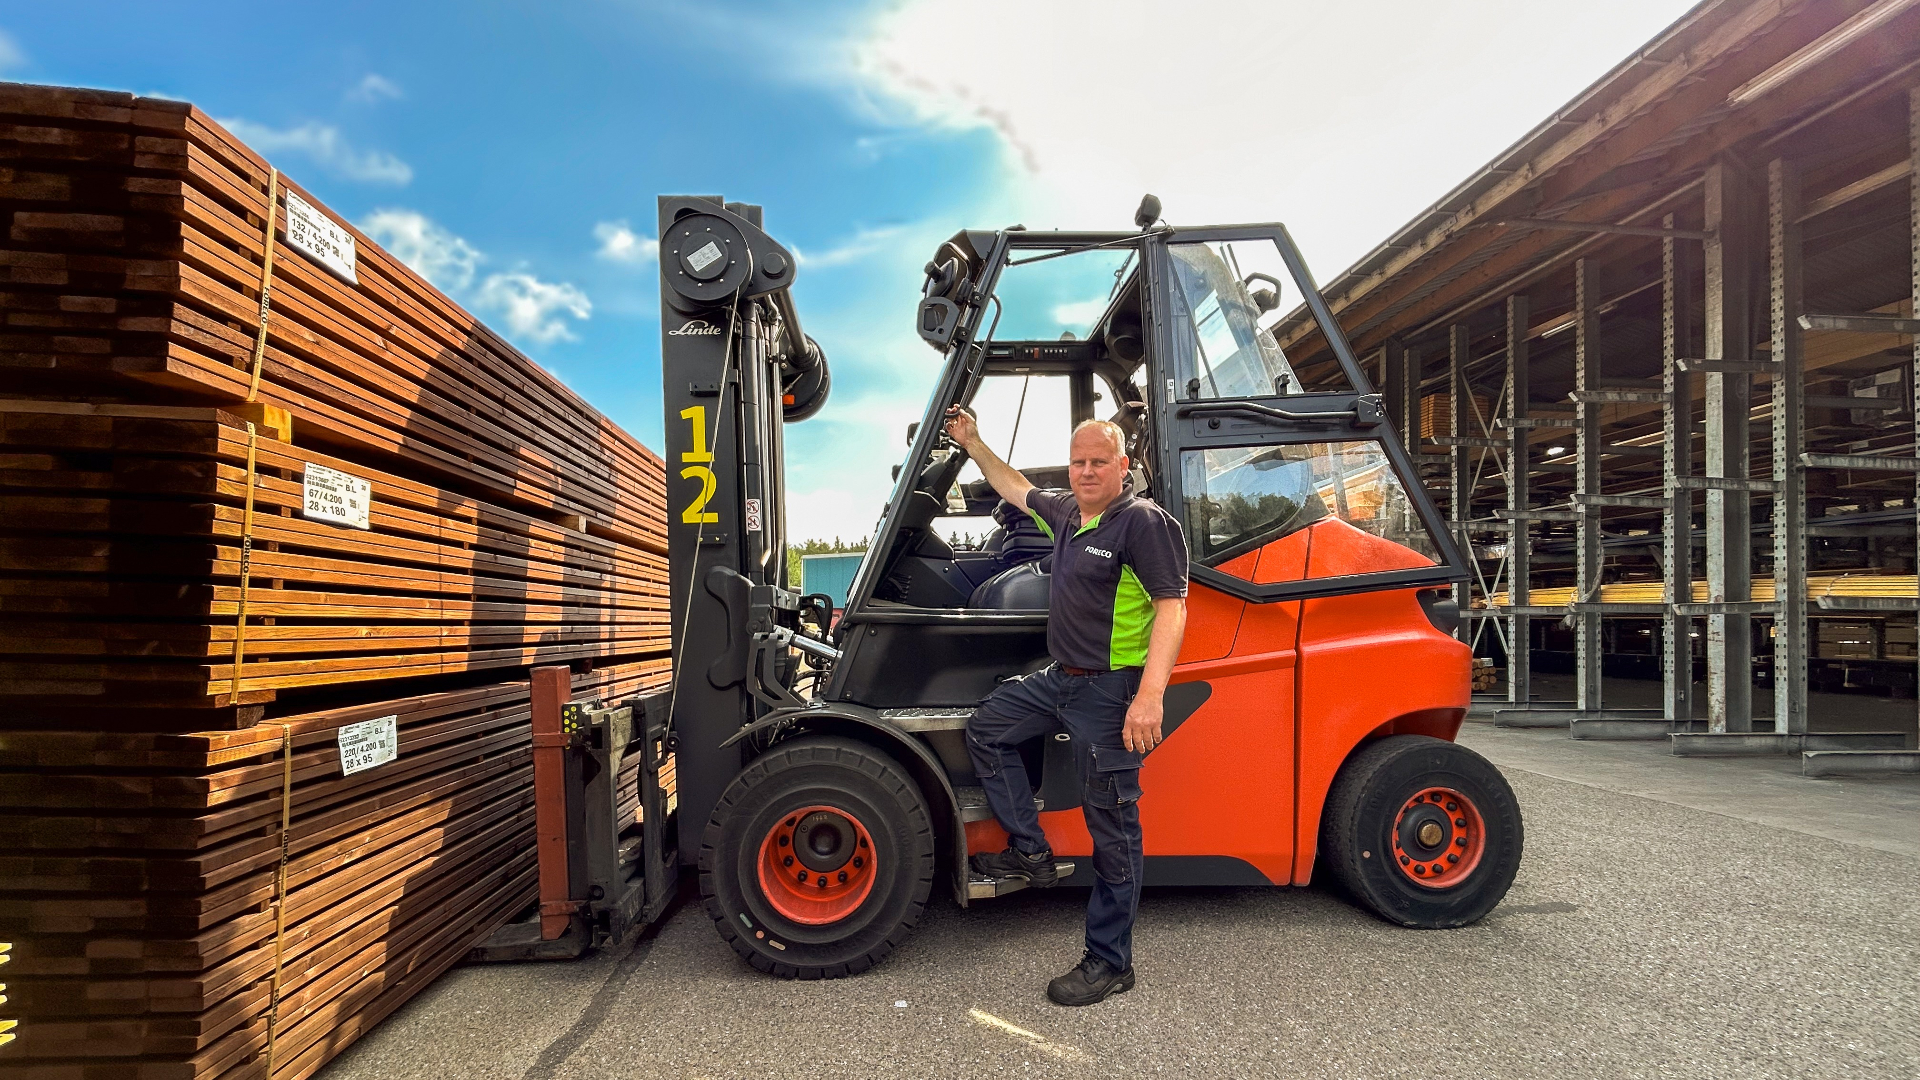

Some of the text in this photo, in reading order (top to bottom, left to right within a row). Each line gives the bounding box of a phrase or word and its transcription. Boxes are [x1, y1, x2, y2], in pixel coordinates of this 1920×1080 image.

[292, 218, 306, 233] 132
[292, 229, 325, 258] 28 x 95
[261, 286, 269, 324] FORECO
[668, 319, 721, 335] Linde
[308, 500, 346, 516] 28 x 180
[243, 533, 251, 573] FORECO
[1084, 545, 1112, 558] FORECO
[344, 747, 356, 758] 220
[345, 753, 373, 769] 28 x 95
